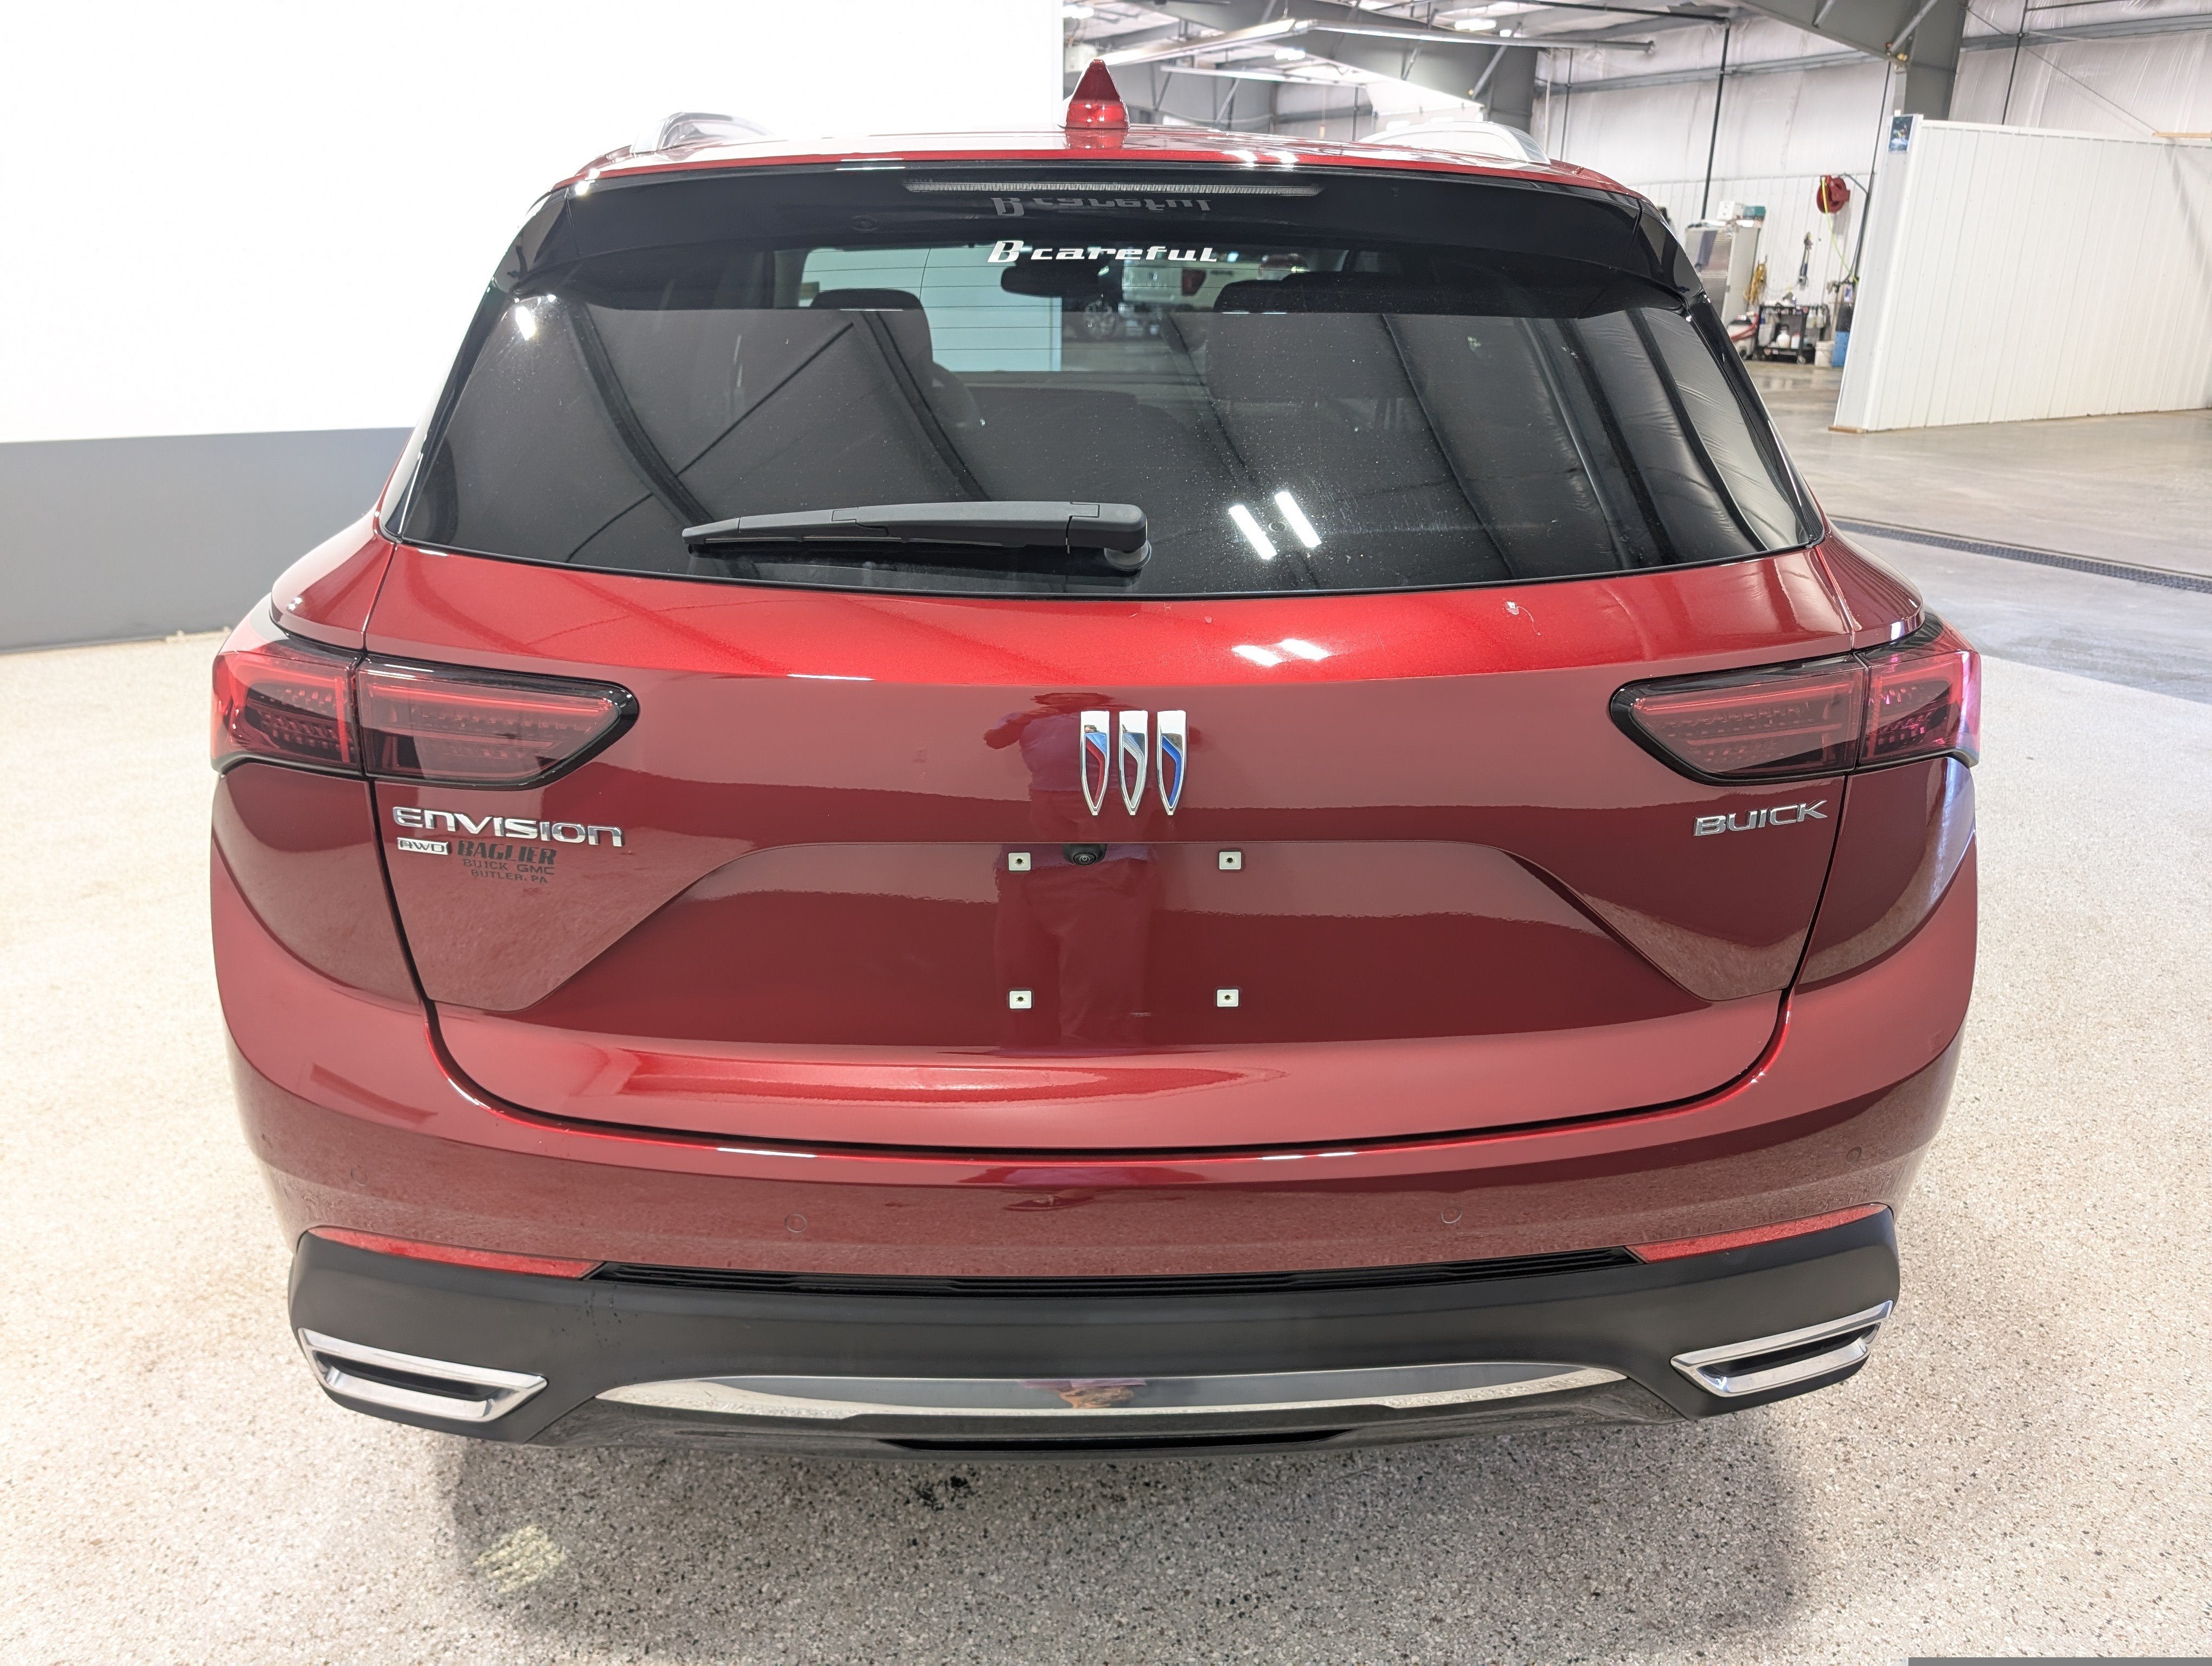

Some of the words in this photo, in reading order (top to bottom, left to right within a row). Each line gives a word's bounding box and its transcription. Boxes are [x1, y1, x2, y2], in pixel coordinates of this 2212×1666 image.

[392, 806, 625, 847] ENVISION
[1693, 799, 1828, 836] BUICK
[399, 840, 445, 853] AWD
[457, 840, 557, 865] BAGLIER
[463, 859, 509, 870] BUICK
[516, 863, 555, 875] GMC
[531, 875, 548, 883] PA
